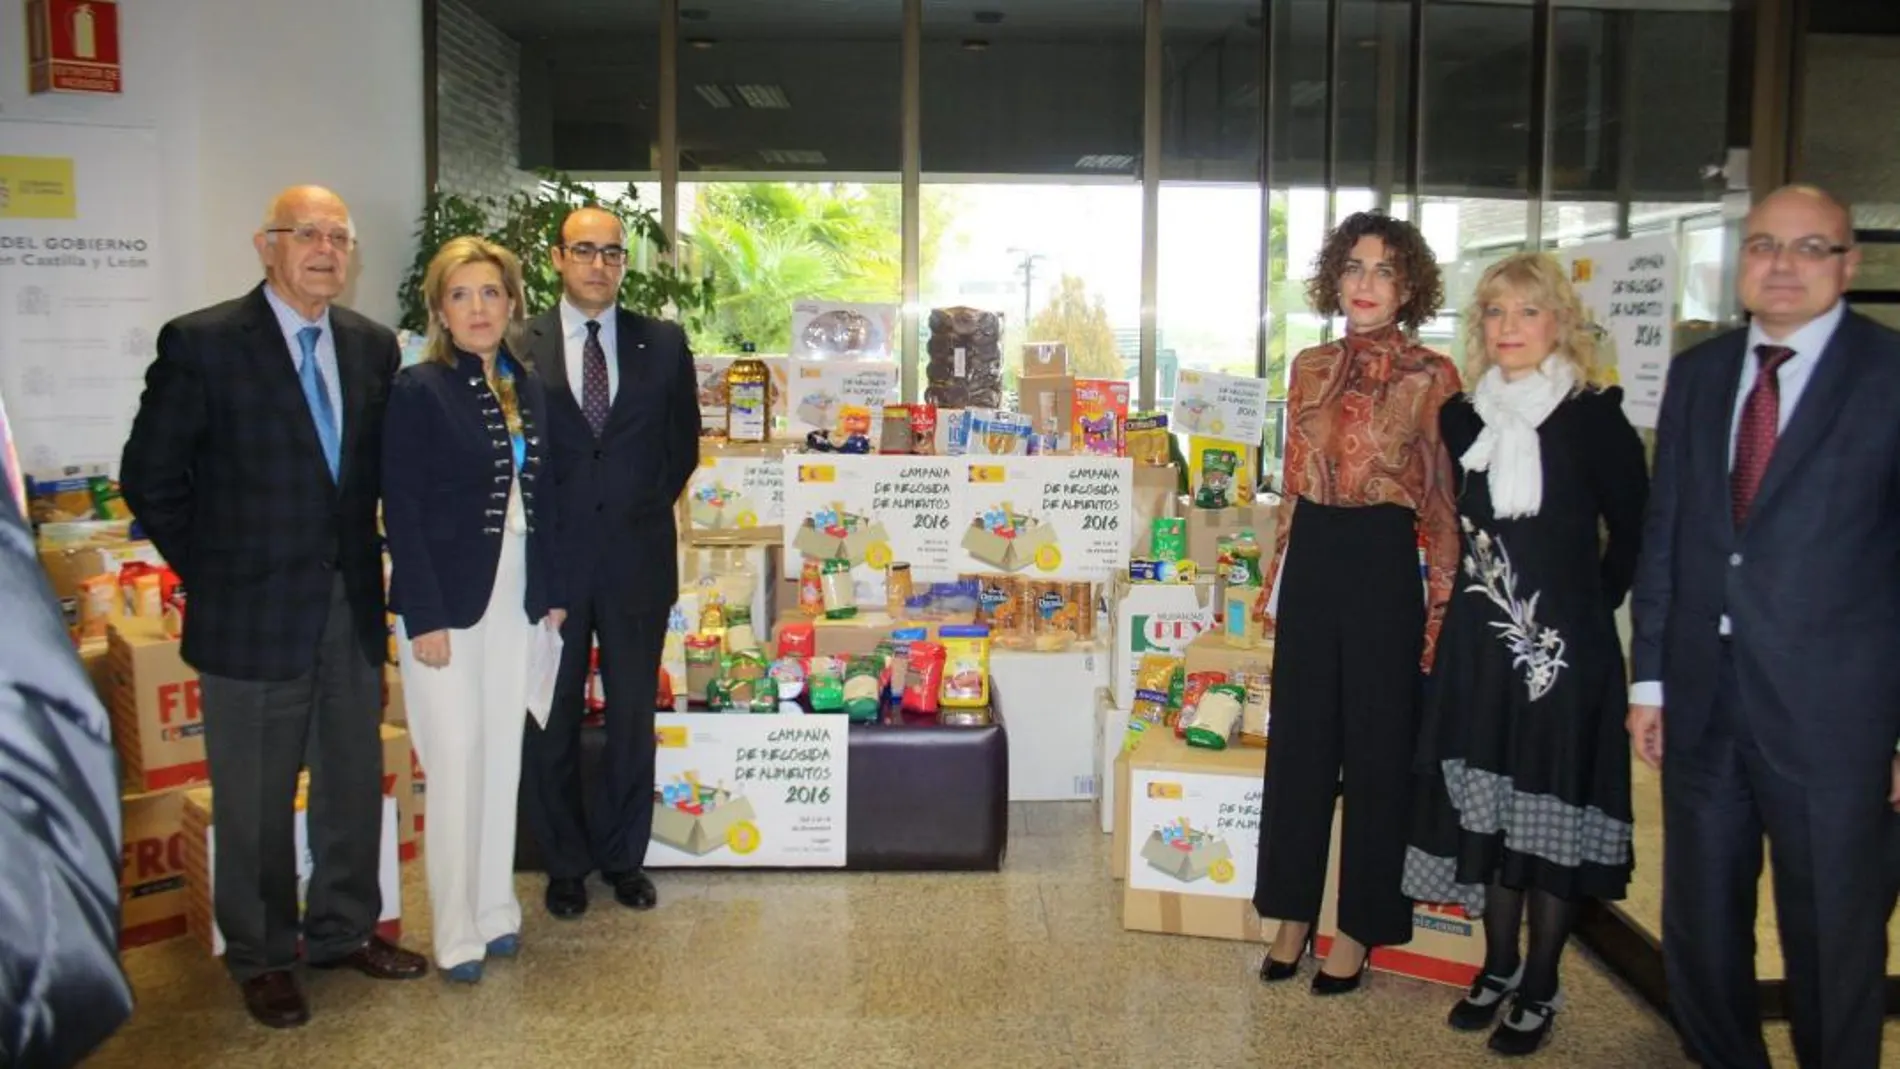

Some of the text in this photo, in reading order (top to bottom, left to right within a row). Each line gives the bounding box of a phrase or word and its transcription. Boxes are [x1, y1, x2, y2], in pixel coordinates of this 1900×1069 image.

[0, 236, 148, 251] DEL GOBIERNO
[21, 254, 87, 266] Castilla
[92, 257, 100, 269] y
[108, 255, 148, 267] León
[913, 514, 949, 529] 2016
[1082, 515, 1118, 530] 2016
[736, 748, 831, 762] DE RECOGIDA
[785, 785, 830, 804] 2016
